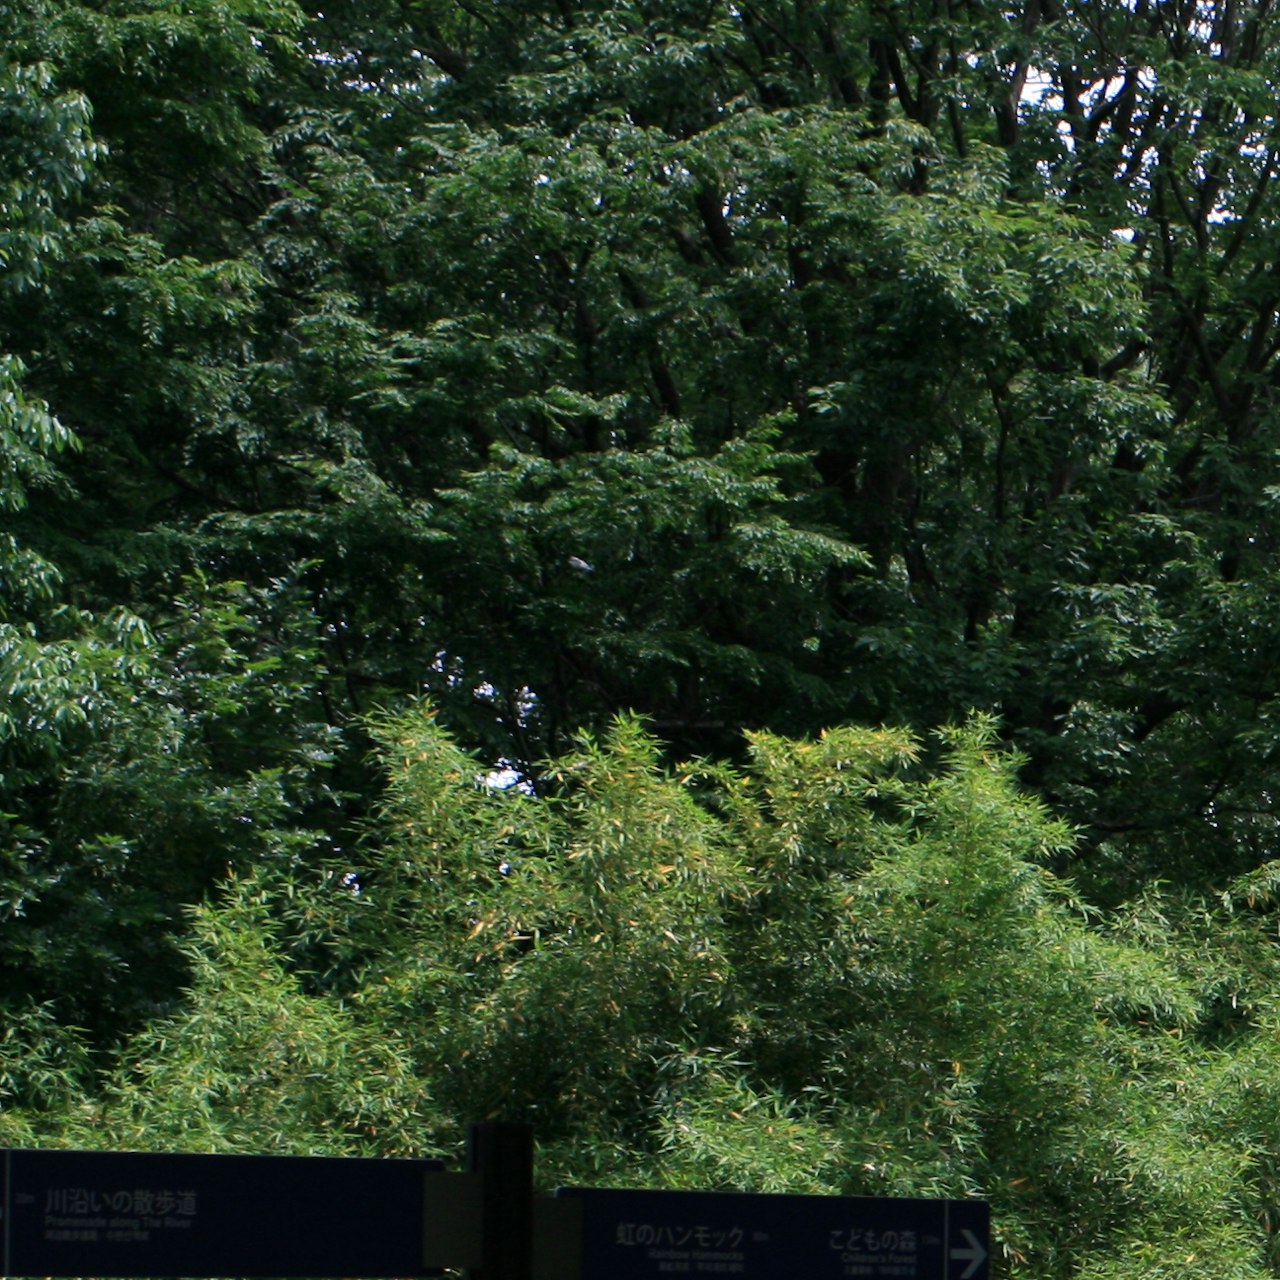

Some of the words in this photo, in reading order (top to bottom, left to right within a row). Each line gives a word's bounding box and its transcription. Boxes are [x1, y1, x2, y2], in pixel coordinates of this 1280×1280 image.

[44, 1188, 197, 1215] 川沿いの散歩道
[616, 1223, 744, 1246] 虹のハンモック
[830, 1229, 917, 1251] こどもの森
